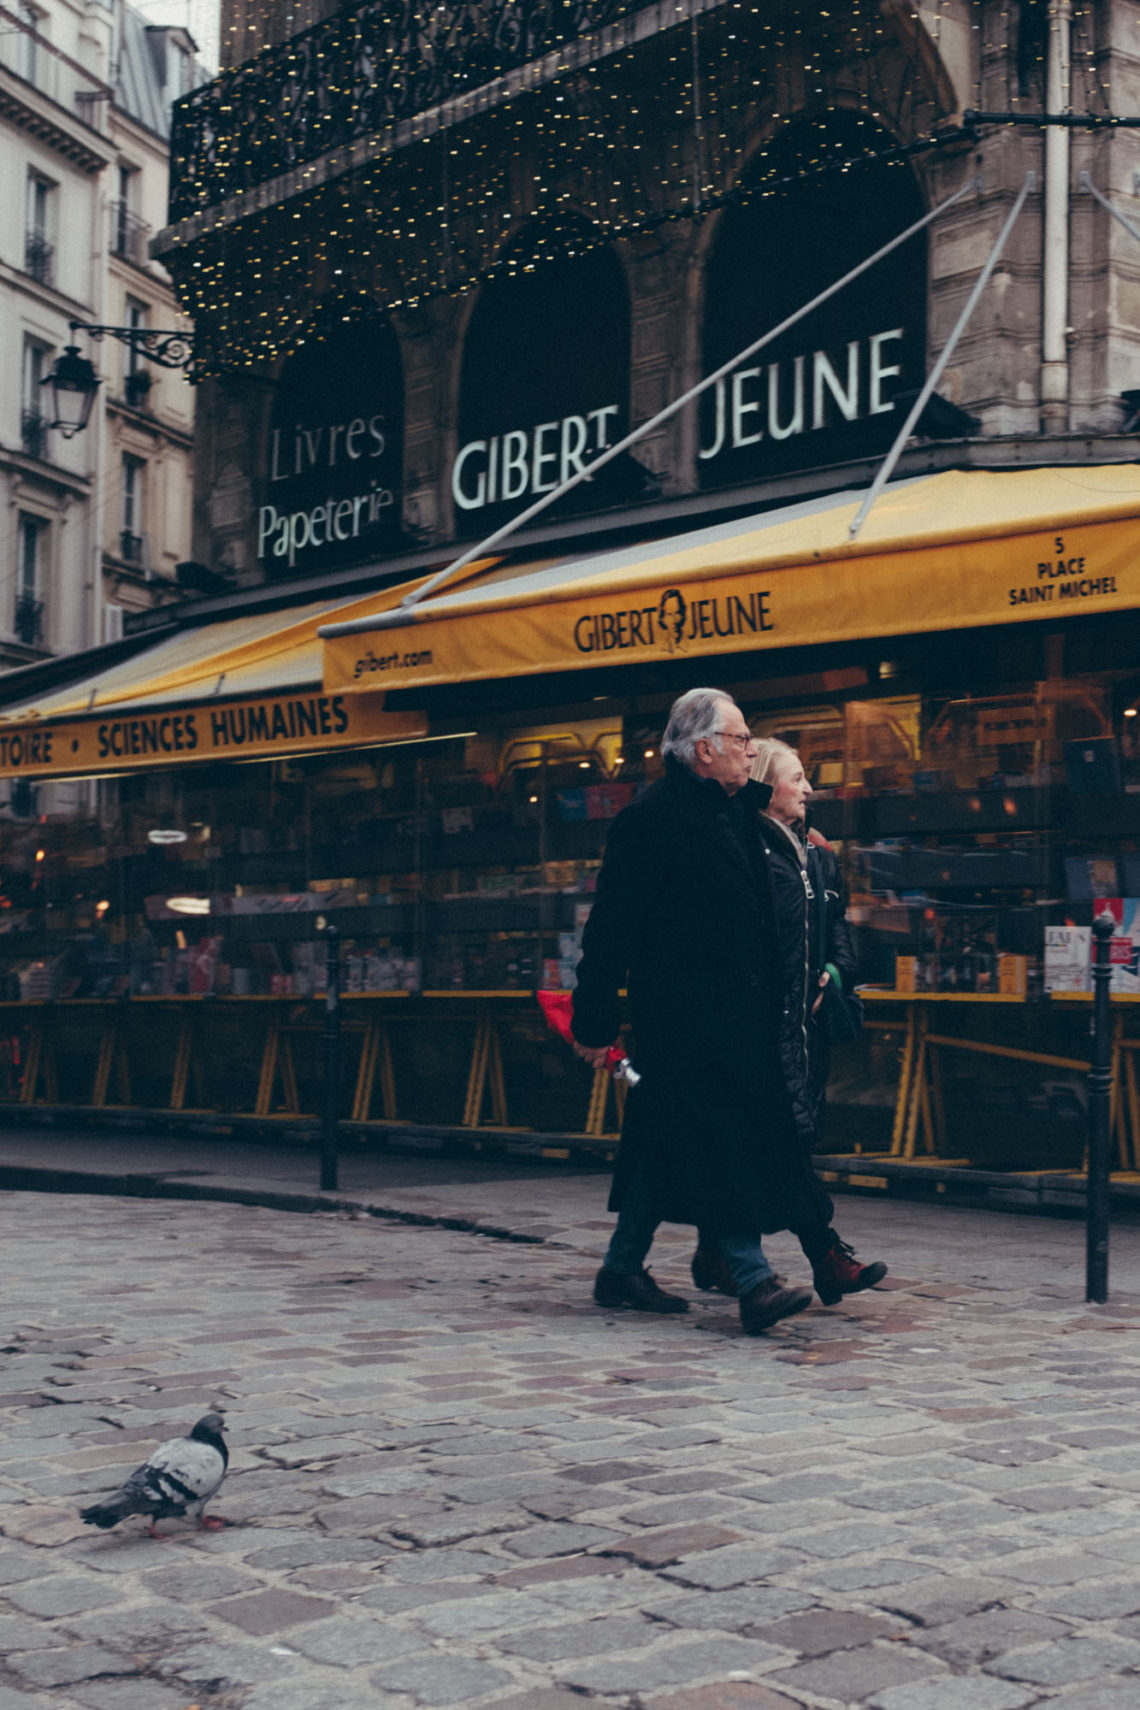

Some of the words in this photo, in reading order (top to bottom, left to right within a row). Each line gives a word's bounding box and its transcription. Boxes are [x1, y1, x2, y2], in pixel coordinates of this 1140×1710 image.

[271, 414, 386, 481] Livres
[452, 404, 619, 510] GIBERT
[699, 328, 904, 460] JEUNE
[257, 480, 394, 568] Papeterie
[1054, 536, 1065, 555] 5
[1009, 584, 1055, 606] SAINT
[1058, 576, 1118, 599] MICHEL
[1037, 557, 1086, 579] PLACE
[574, 606, 658, 653] GIBERT
[687, 591, 773, 640] JEUNE
[353, 649, 434, 679] gibert.com
[0, 731, 53, 768] TOIRE
[97, 713, 198, 759] SCIENCES
[210, 696, 349, 747] HUMAINES
